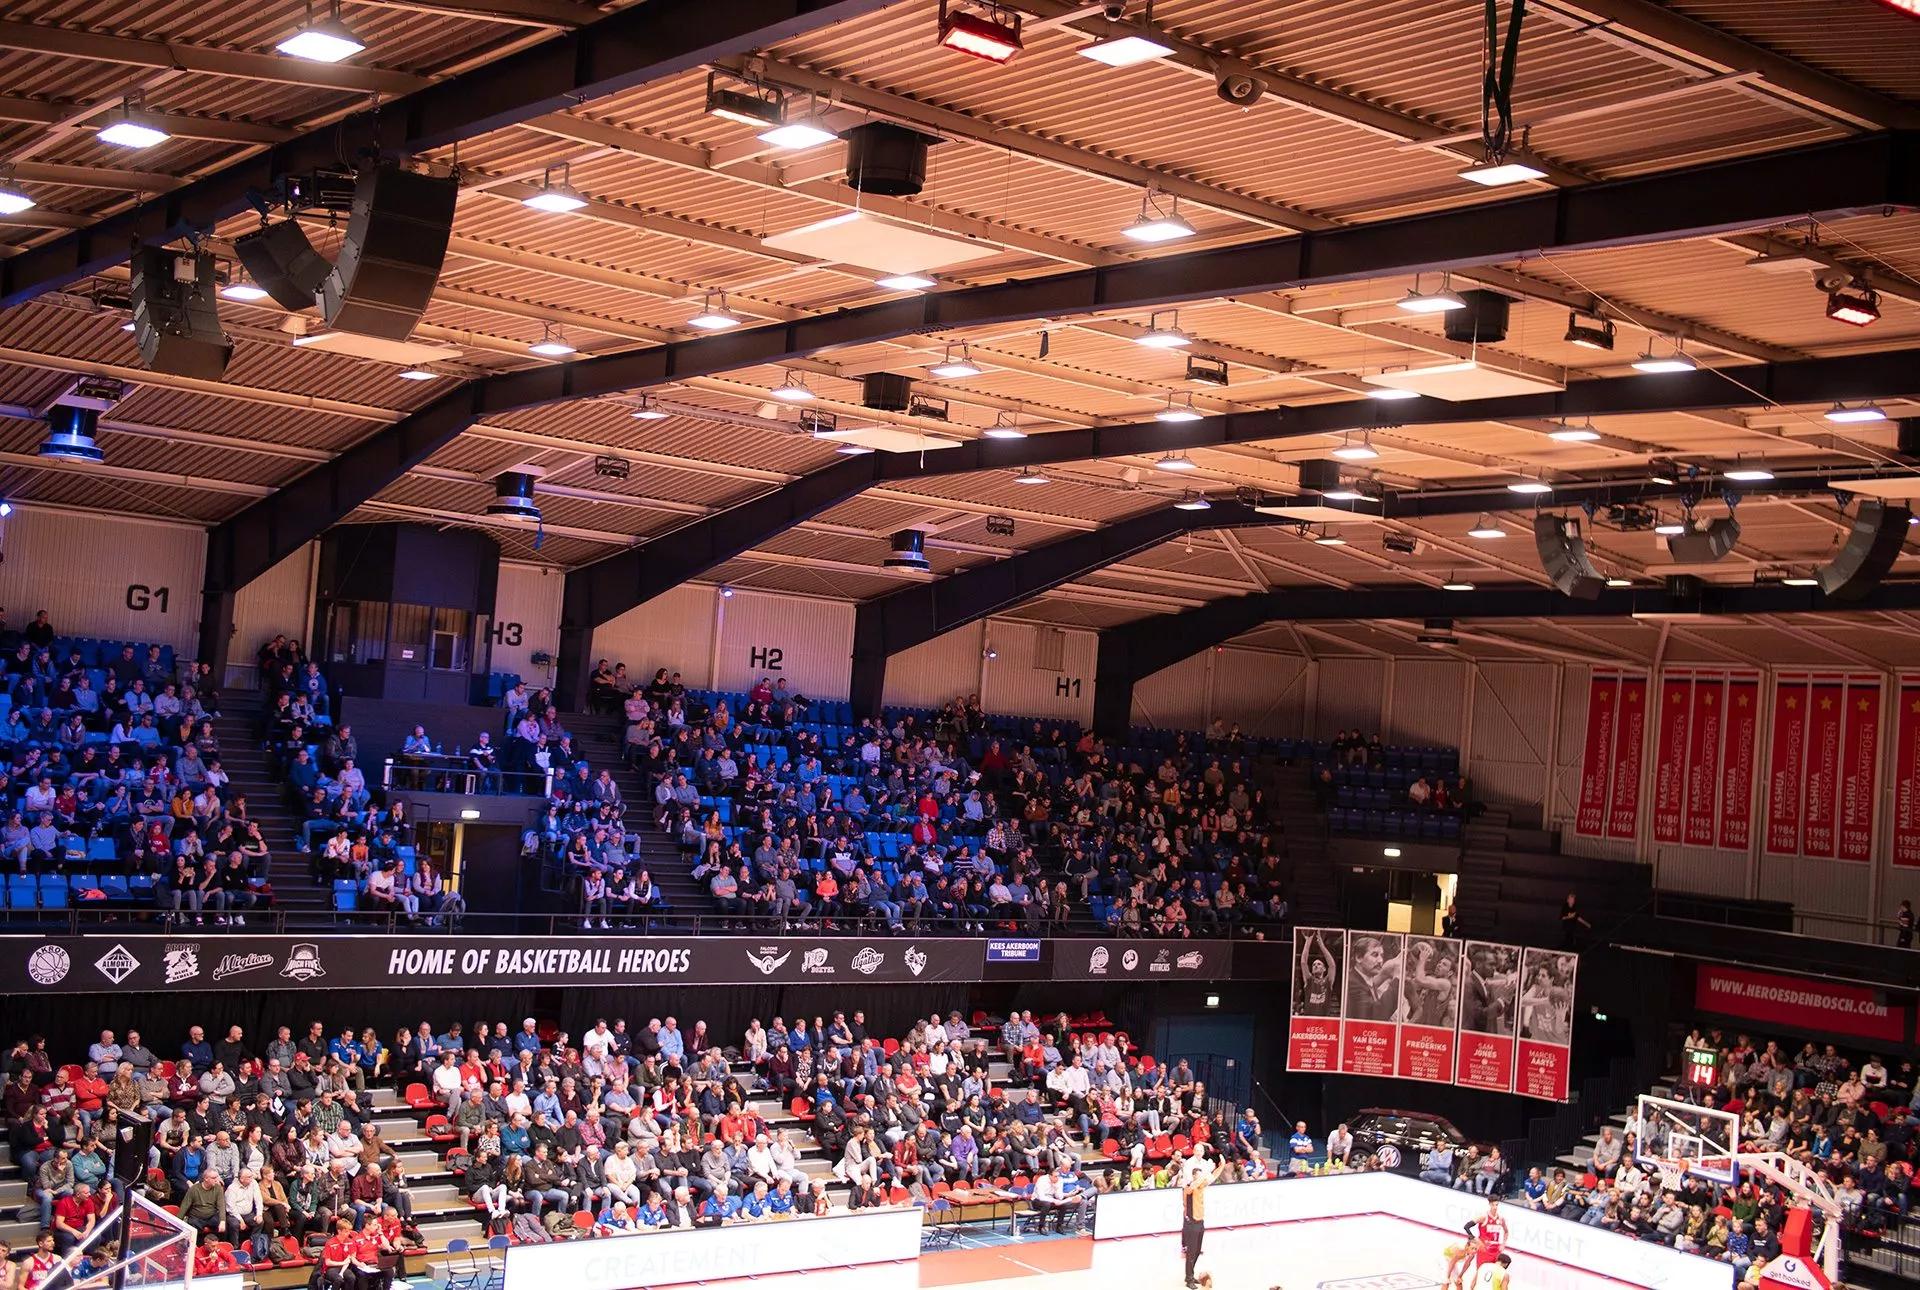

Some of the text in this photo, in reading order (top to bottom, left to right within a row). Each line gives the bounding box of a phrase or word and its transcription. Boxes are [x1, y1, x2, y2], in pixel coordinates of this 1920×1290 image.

[126, 584, 170, 613] G1
[486, 621, 523, 647] H3
[750, 646, 784, 671] H2
[1056, 676, 1081, 700] H1
[1616, 760, 1627, 806] NASHUA
[1659, 763, 1670, 809] NASHUA
[1691, 765, 1701, 812] NASHUA
[1726, 767, 1736, 815] NASHUA
[1774, 770, 1784, 819] NASHUA
[1809, 772, 1819, 822] NASHUA
[1845, 775, 1856, 825] NASHUA
[1899, 778, 1911, 829] NASHUA
[1806, 839, 1830, 851] 1986
[1843, 831, 1868, 842] 1986
[1843, 843, 1868, 855] 1987
[35, 945, 66, 957] AKROS
[388, 949, 691, 974] HOME OF BASKETBALL HEROES
[31, 967, 67, 983] BOXMEER
[102, 960, 132, 968] ALMONTE
[214, 953, 272, 974] Migliore
[1710, 977, 1887, 1017] WWW.HEROESDENBOSCH.COM
[1353, 1036, 1367, 1044] VAN
[1406, 1040, 1447, 1051] FREDERIKS
[1474, 1049, 1497, 1058] JONES
[1693, 1064, 1713, 1085] 14
[1769, 1270, 1811, 1287] get hooked
